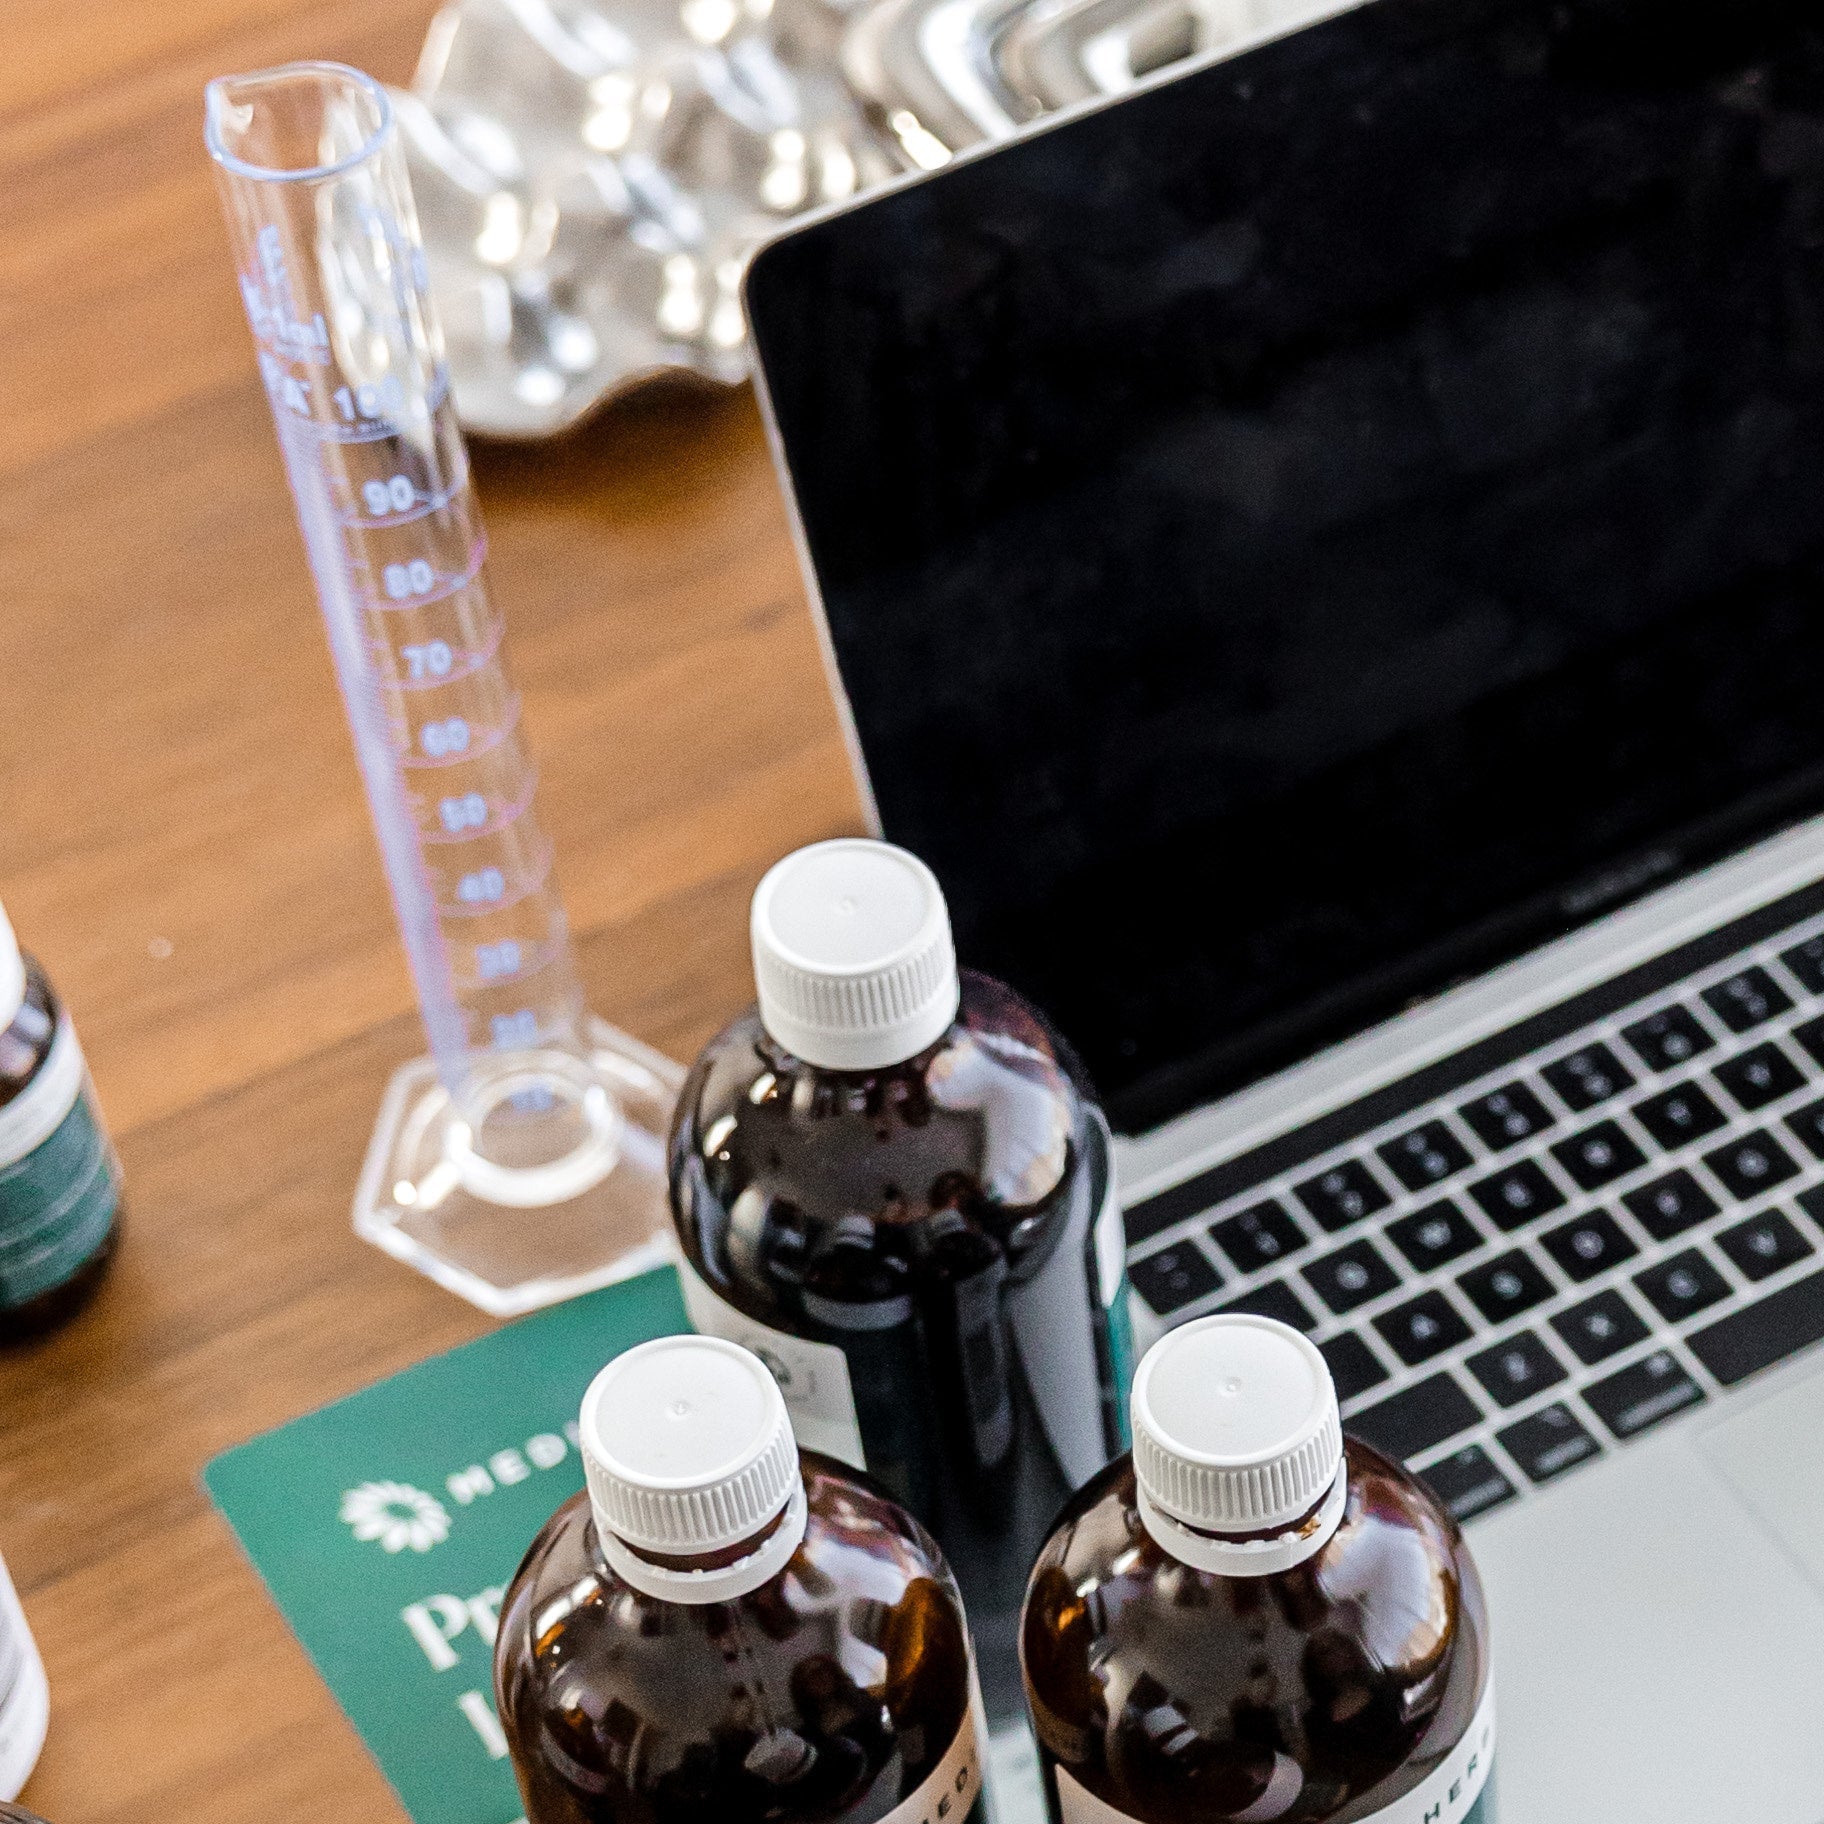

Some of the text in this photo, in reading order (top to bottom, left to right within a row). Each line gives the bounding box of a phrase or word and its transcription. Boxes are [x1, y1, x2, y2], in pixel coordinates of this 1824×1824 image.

[363, 473, 416, 516] 90
[382, 557, 434, 600] 80
[402, 638, 452, 680] 70
